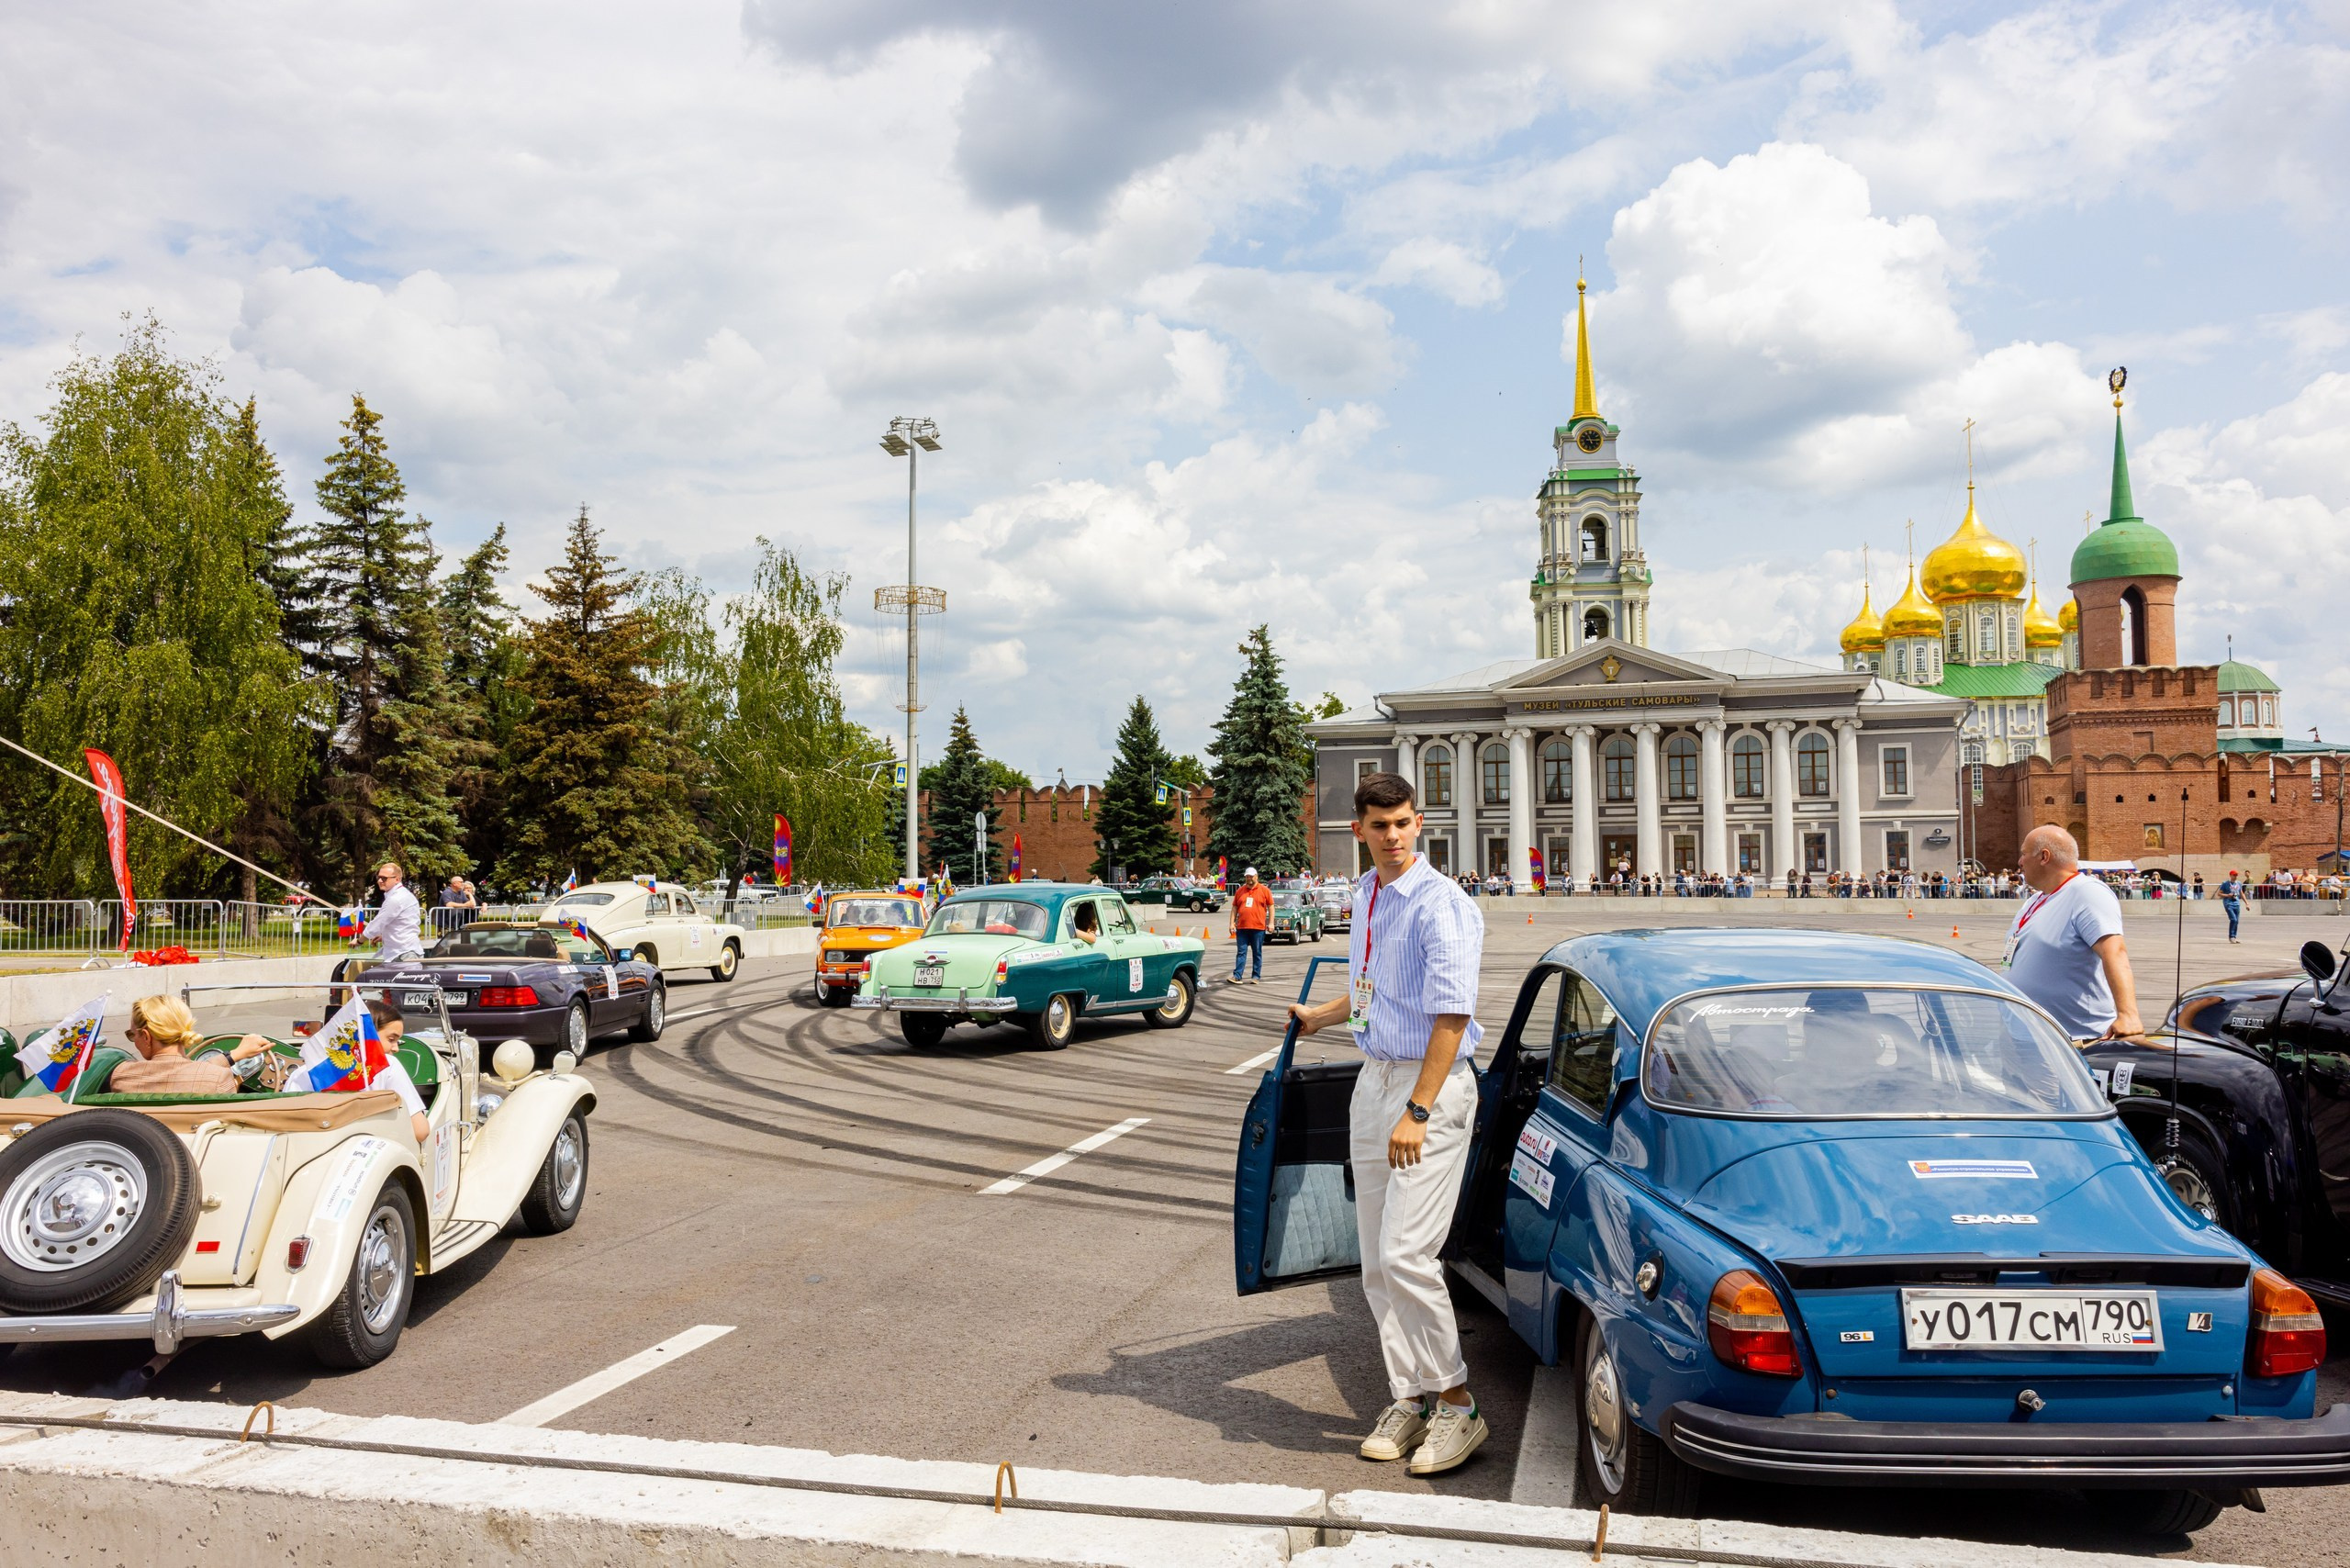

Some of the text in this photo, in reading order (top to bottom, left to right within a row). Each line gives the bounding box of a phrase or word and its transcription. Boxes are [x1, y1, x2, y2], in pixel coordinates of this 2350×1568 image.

[1524, 695, 1700, 711] МУЗЕЙ «ТУЛЬСКИЕ САМОВАРЫ»
[407, 992, 464, 1004] К04 799
[1689, 1002, 1815, 1023] Автострада
[1951, 1214, 2039, 1225] SAAB
[2084, 1299, 2146, 1331] 790
[1843, 1332, 1872, 1340] 96 L
[2102, 1331, 2132, 1344] RUS
